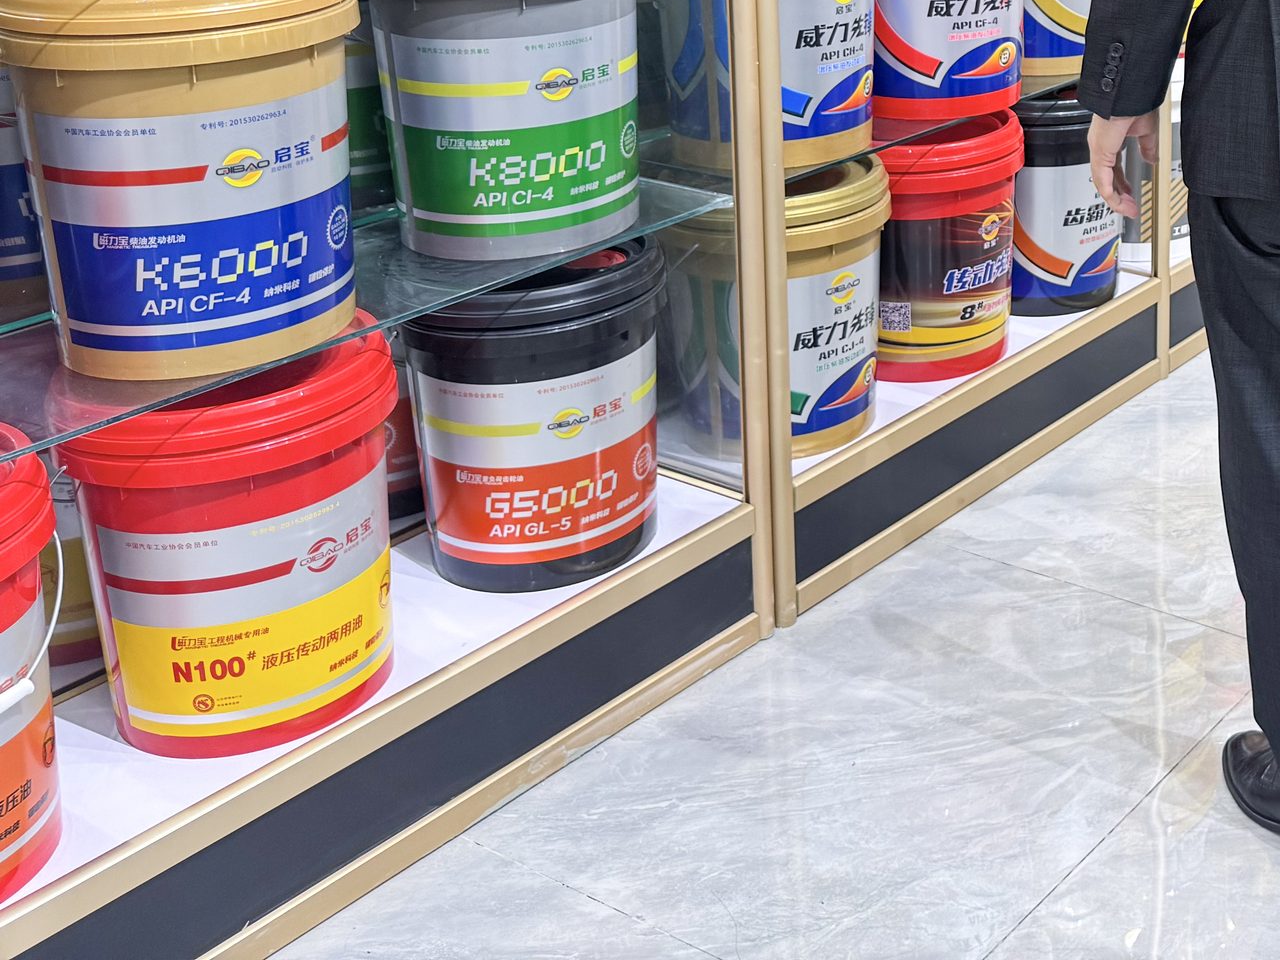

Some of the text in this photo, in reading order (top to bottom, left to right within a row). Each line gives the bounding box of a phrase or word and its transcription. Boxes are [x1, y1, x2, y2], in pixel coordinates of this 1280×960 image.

[795, 9, 872, 49] 威力先锋
[952, 17, 998, 30] API CF-4
[820, 50, 840, 61] API
[535, 77, 578, 90] QIBAO
[581, 63, 610, 83] 启宝
[64, 127, 157, 137] 中国汽车工业协会会员单位
[229, 109, 288, 127] 201530262963.4
[274, 140, 311, 164] 启宝
[215, 159, 270, 176] QIBAO
[469, 140, 606, 187] K8000
[473, 192, 506, 208] API
[1083, 225, 1098, 236] API
[136, 231, 308, 292] K6000
[825, 278, 860, 296] QIBAO
[141, 279, 300, 317] API CF-4 纳米科技
[793, 296, 875, 351] 威力先锋
[819, 348, 838, 361] API
[593, 397, 622, 419] 启宝
[547, 415, 590, 431] QIBAO
[485, 469, 618, 519] G5000
[345, 516, 372, 545] 启宝
[490, 522, 520, 538] API
[299, 541, 344, 567] QIBAO
[207, 627, 270, 646] 工程机械专用油
[261, 613, 363, 672] 液压传动两用油
